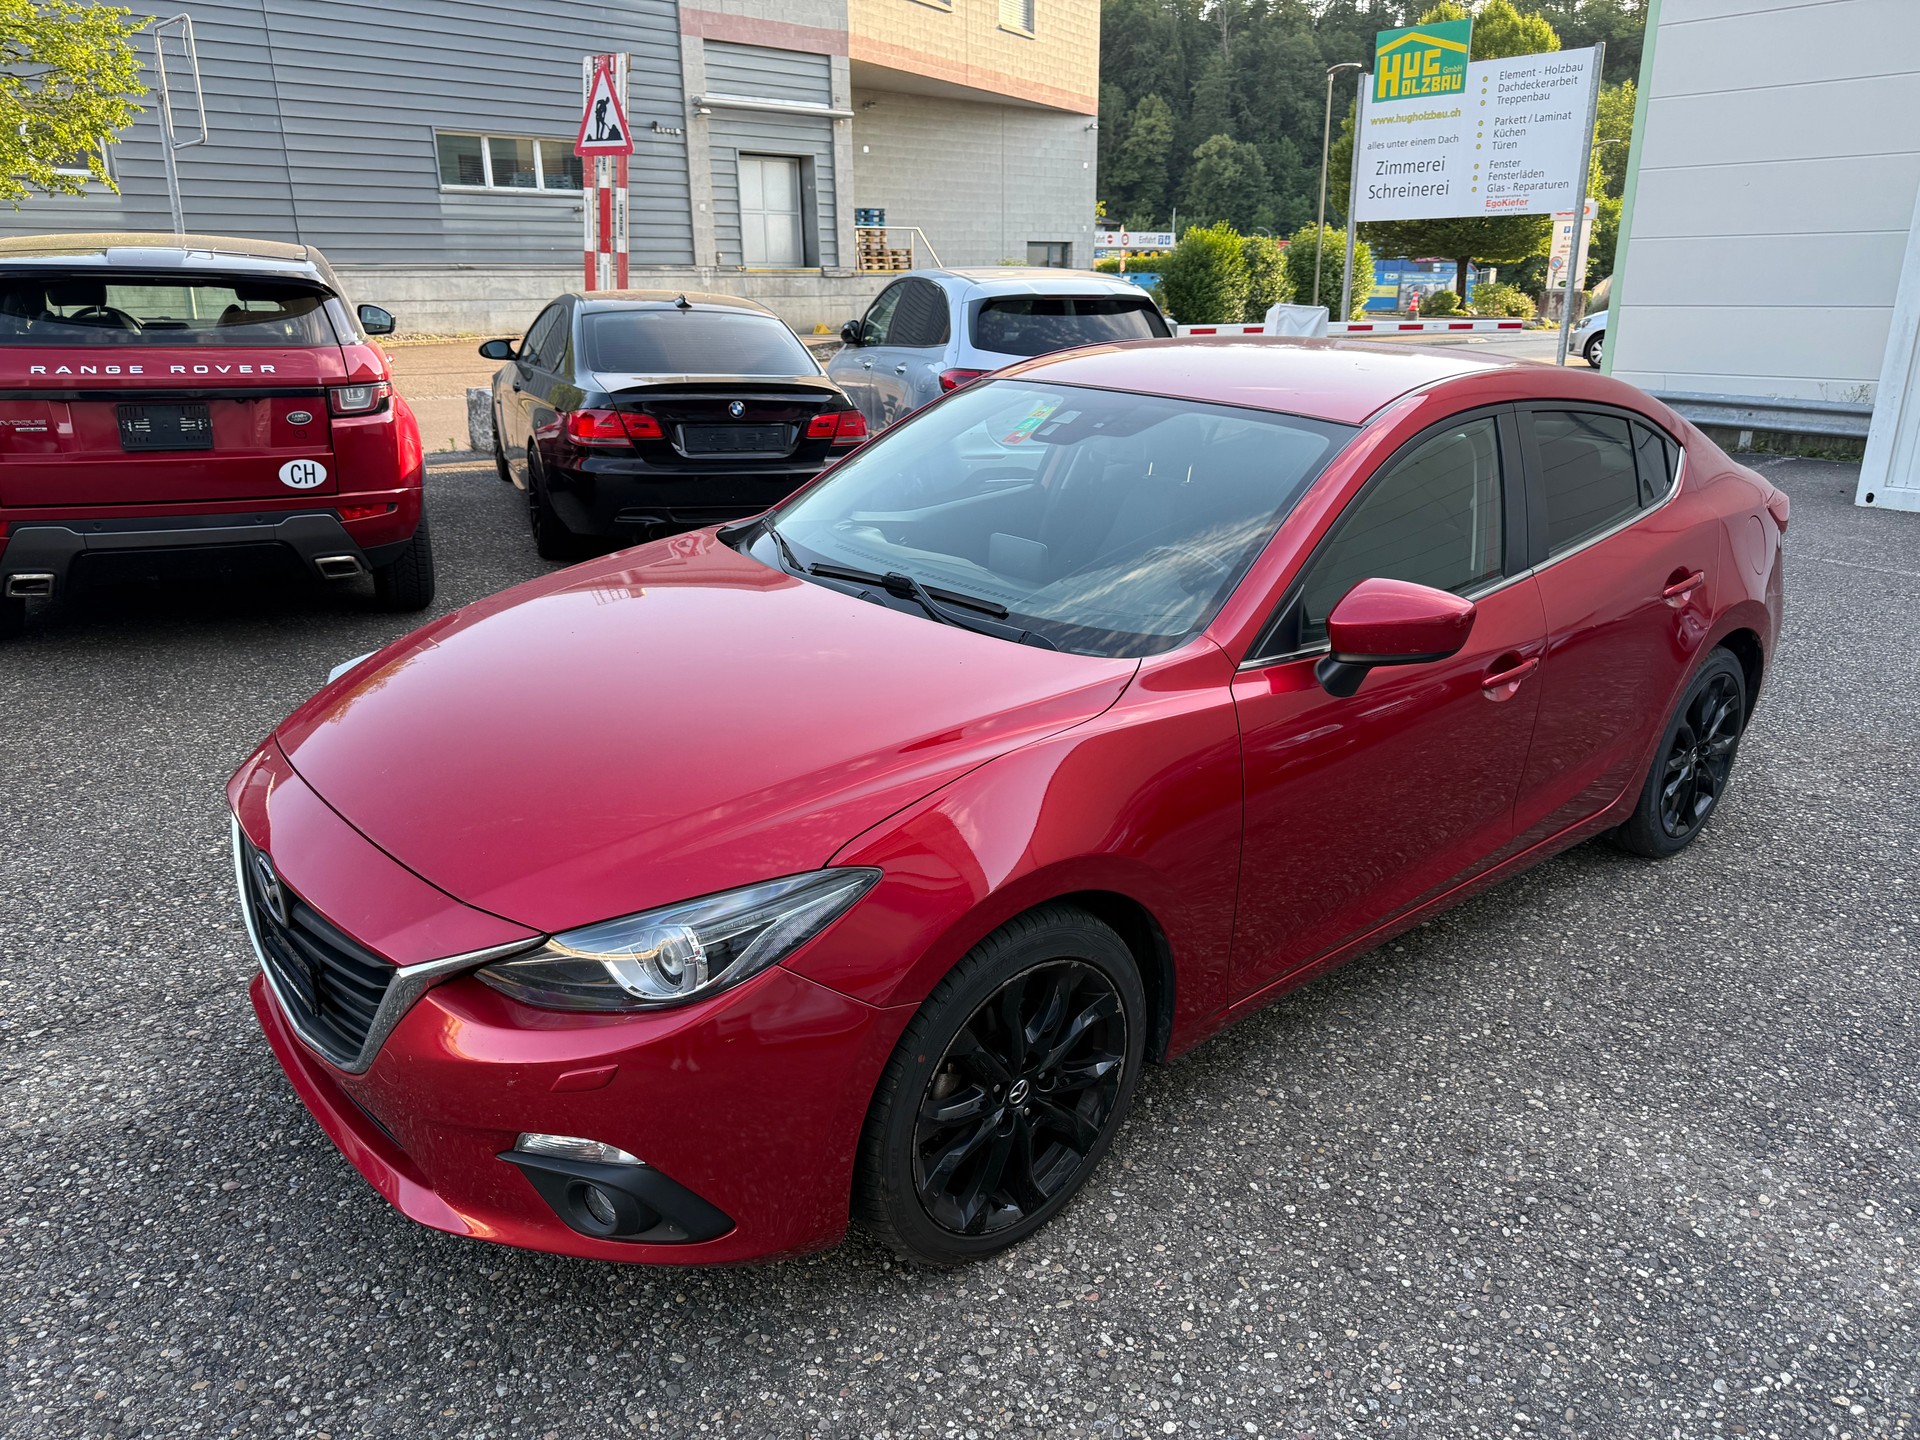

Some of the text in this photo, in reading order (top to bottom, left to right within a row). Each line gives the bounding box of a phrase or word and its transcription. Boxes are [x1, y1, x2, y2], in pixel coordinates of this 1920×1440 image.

[1443, 65, 1463, 74] GmbH
[1499, 68, 1536, 80] Element
[1544, 63, 1584, 75] Holzbau
[1498, 76, 1578, 92] Dachdeckerarbeit
[1497, 92, 1551, 106] Treppenbau
[1370, 107, 1462, 125] www.hugholzbau.ch
[1494, 115, 1527, 126] Parkett
[1534, 111, 1572, 122] Laminat
[1493, 127, 1526, 138] Küchen
[1367, 134, 1459, 150] alles unter einem Dach
[1492, 140, 1518, 150] Türen
[1375, 155, 1446, 176] Zimmerei
[1489, 160, 1521, 169] Fenster
[1488, 169, 1545, 181] Fensterläden
[1368, 179, 1450, 200] Schreinerei
[1487, 183, 1505, 193] Glas
[1512, 181, 1569, 192] Reparaturen
[1485, 198, 1529, 208] EgoKiefer
[30, 364, 277, 375] RANGE ROVER
[290, 463, 316, 485] CH
